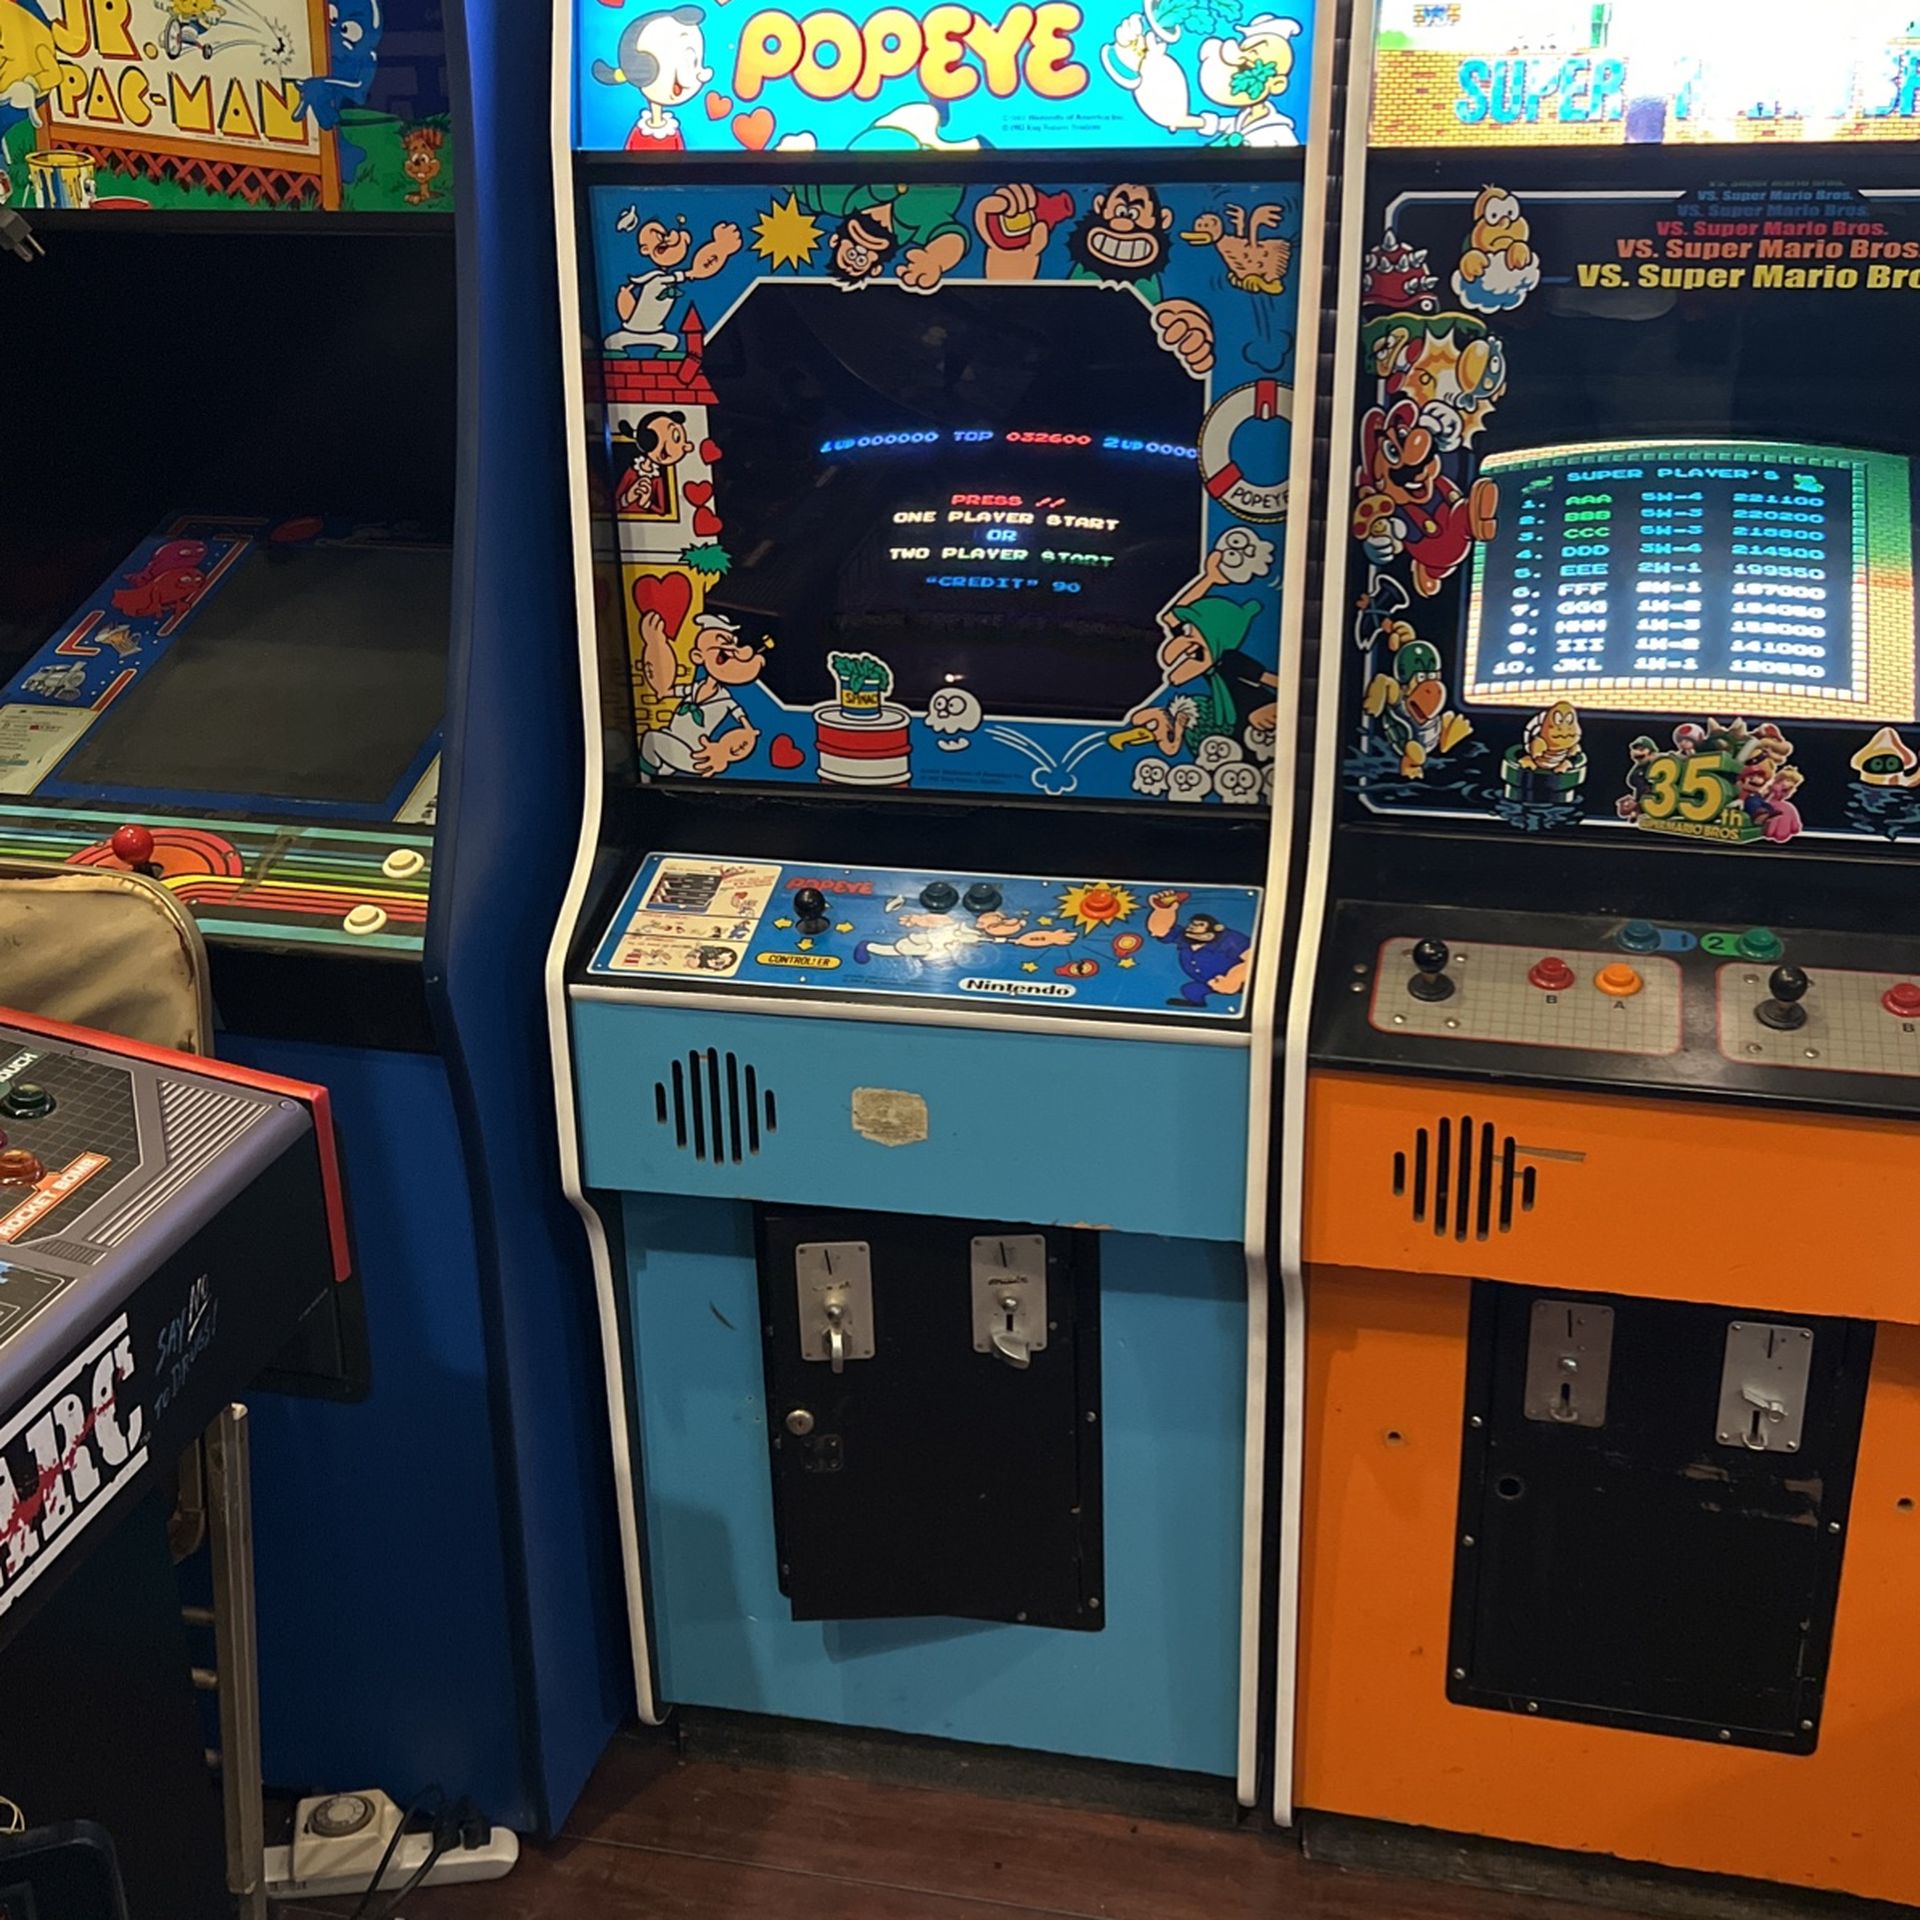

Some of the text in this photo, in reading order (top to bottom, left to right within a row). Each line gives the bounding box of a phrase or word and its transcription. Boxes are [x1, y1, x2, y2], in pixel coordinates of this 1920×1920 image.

[732, 1, 1091, 103] POPEYE
[1455, 57, 1627, 125] SUPER
[55, 59, 309, 145] PAC-MAN
[1697, 190, 1854, 202] VS. Super Mario Bros.
[1677, 205, 1704, 217] VS.
[1708, 205, 1763, 219] Super
[1766, 204, 1820, 217] Mario
[1656, 221, 1889, 238] VS. Super Mario Bros.
[1616, 239, 1660, 258] VS.
[1666, 239, 1753, 260] Super
[1758, 239, 1844, 259] Mario
[1577, 264, 1631, 288] VS.
[1638, 264, 1746, 290] Super
[1752, 264, 1859, 289] Mario
[953, 431, 994, 442] TOP
[1006, 431, 1092, 446] 032600
[1566, 467, 1780, 482] SUPER PLAYER'S
[951, 494, 1023, 507] PRESS
[1521, 499, 1546, 509] 1.
[1565, 494, 1613, 506] AAA
[1732, 492, 1825, 507] 221100
[892, 510, 1120, 531] ONE PLAYER START
[1519, 515, 1546, 525] 2.
[1564, 510, 1611, 522] BBB
[1732, 508, 1825, 524] 220200
[985, 528, 1018, 542] OR
[1517, 531, 1544, 541] 3.
[1562, 526, 1611, 539] CCC
[889, 547, 931, 560] TWO
[941, 547, 1029, 561] PLAYER
[1515, 549, 1543, 560] 4.
[1561, 544, 1610, 557] DDD
[1560, 563, 1609, 577] EEE
[1051, 581, 1082, 593] 90
[1557, 581, 1608, 597] FFF
[1554, 618, 1607, 634] HHH
[1555, 637, 1605, 653] III
[1492, 660, 1535, 675] 10.
[1552, 657, 1604, 673] JKL
[1680, 934, 1689, 949] 1
[1707, 936, 1725, 951] 2
[966, 979, 1071, 998] Nintendo
[1545, 994, 1558, 1005] B
[1613, 1000, 1625, 1010] A
[51, 1158, 98, 1191] BOMB
[155, 1306, 188, 1377] SAY
